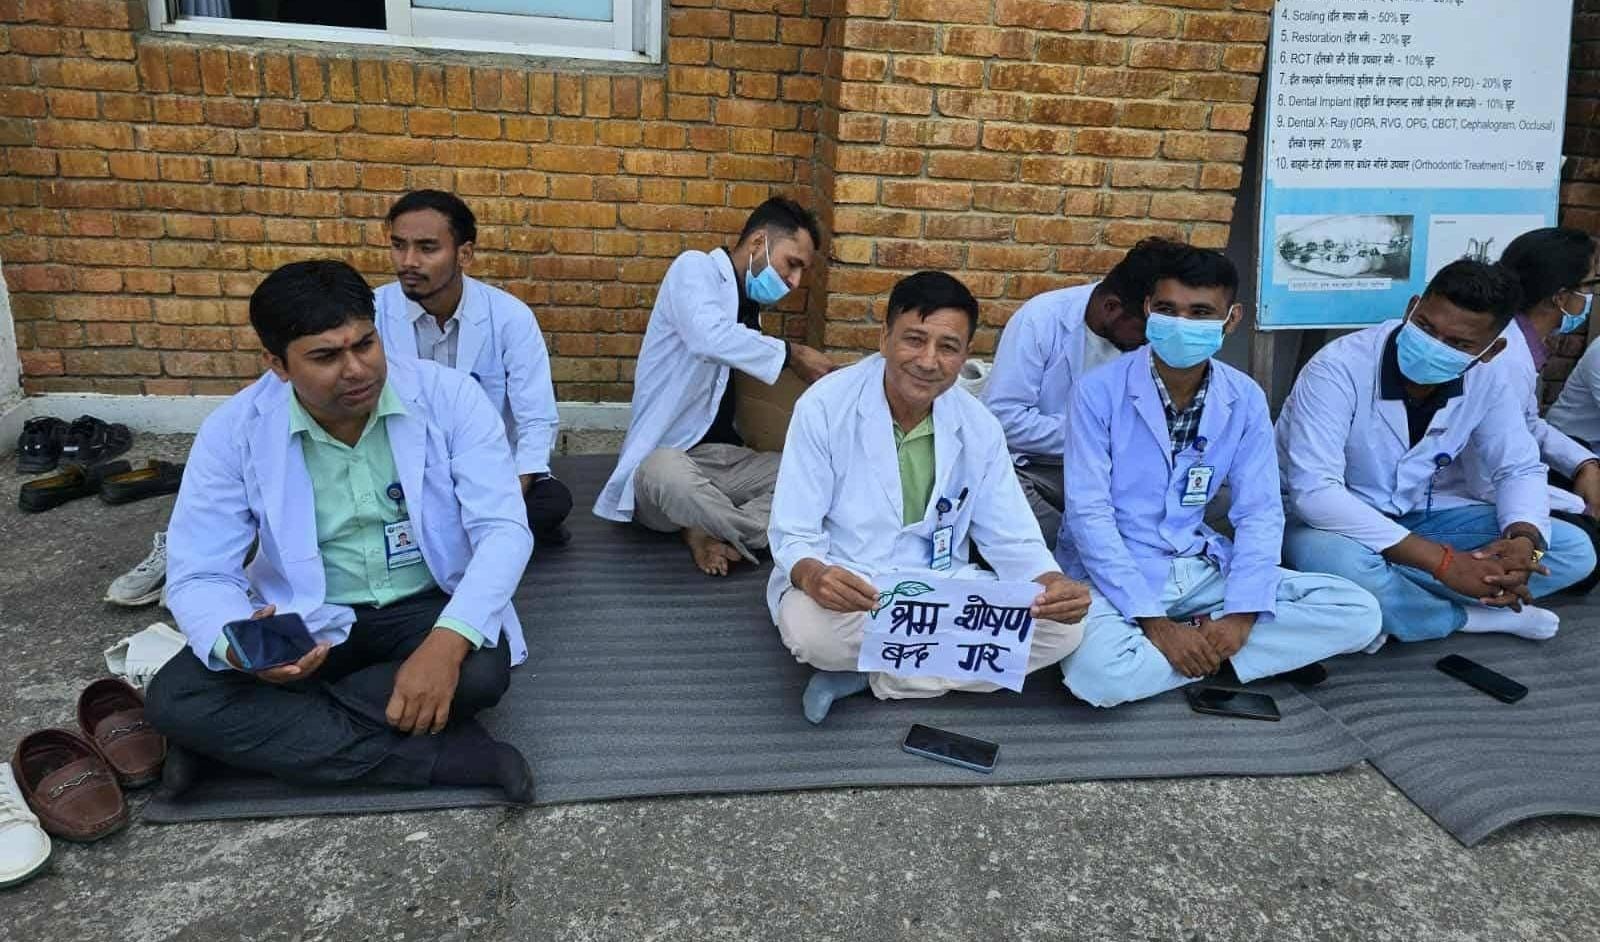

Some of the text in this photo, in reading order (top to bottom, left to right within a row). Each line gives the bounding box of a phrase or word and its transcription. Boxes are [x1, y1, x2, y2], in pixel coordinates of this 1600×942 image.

[1281, 9, 1290, 21] 4.
[1292, 10, 1324, 24] Scaling
[1378, 12, 1398, 22] 50%
[1281, 30, 1289, 42] 5.
[1292, 31, 1342, 43] Restoration
[1379, 33, 1399, 44] 20%
[1280, 51, 1288, 64] 6.
[1291, 53, 1312, 64] RCT
[1405, 55, 1424, 66] 10%
[1280, 72, 1288, 85] 7.
[1407, 76, 1424, 88] (CD,
[1427, 77, 1449, 88] RPD,
[1452, 77, 1474, 89] FPD)
[1482, 78, 1500, 89] 20%
[1278, 94, 1286, 107] 8.
[1288, 95, 1317, 106] Dental
[1320, 96, 1352, 109] Implant
[1487, 99, 1503, 109] 10%
[1277, 115, 1285, 127] 9.
[1288, 117, 1316, 128] Dental
[1331, 117, 1347, 130] Ray
[1350, 117, 1377, 129] (IOPA,
[1380, 117, 1403, 129] RVG,
[1406, 118, 1429, 129] OPG,
[1432, 118, 1458, 130] CBCT,
[1518, 120, 1555, 132] Occlusal)
[1331, 139, 1350, 149] 20%
[1276, 157, 1289, 170] 10.
[1412, 159, 1462, 171] (Orthodontic
[1464, 160, 1507, 172] Treatment)
[1518, 161, 1534, 171] 10%
[881, 641, 1011, 673] बन्द गर
